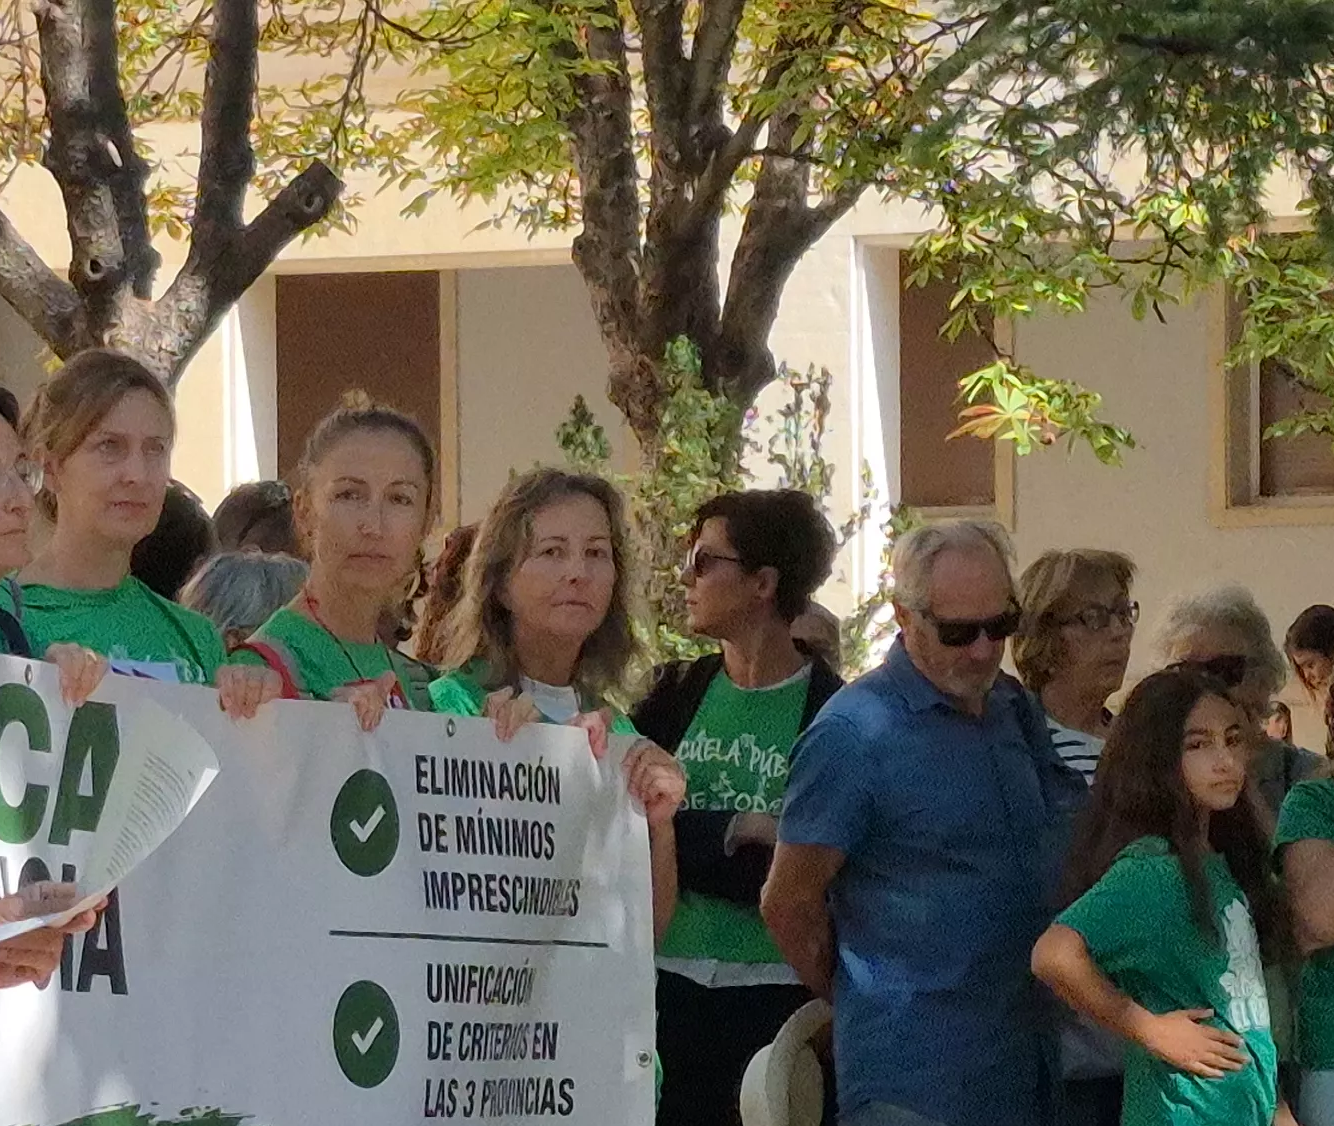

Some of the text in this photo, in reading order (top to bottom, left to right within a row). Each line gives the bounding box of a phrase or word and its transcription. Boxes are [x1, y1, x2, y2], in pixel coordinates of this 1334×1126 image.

[415, 754, 561, 806] ELIMINACIÓN
[418, 807, 556, 861] DE MÍNIMOS
[426, 958, 536, 1006] UNIFICACIÓN
[427, 1021, 559, 1061] DE CRITERIOS EN
[424, 1076, 576, 1118] LAS 3 PROVINCIAS
